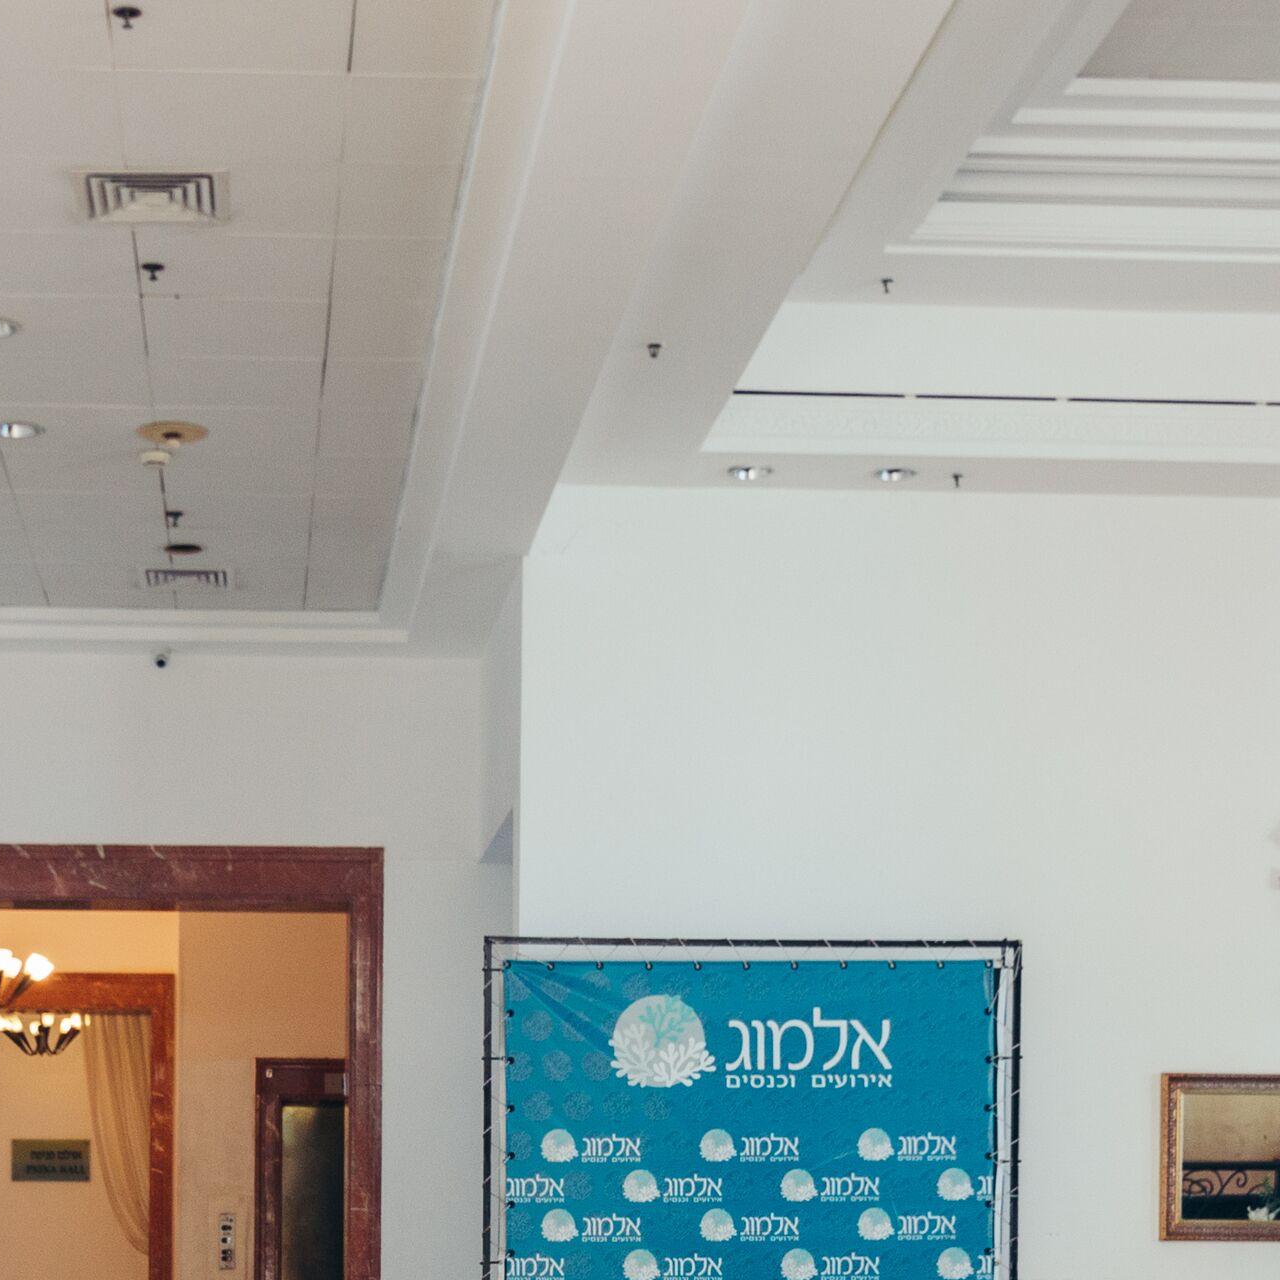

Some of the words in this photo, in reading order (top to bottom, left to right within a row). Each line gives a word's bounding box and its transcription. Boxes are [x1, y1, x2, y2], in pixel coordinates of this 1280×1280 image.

[726, 1007, 893, 1071] אלמוג
[725, 1073, 797, 1089] וכנסים
[811, 1073, 893, 1089] אירועים
[582, 1134, 641, 1156] אלמוג
[740, 1134, 799, 1156] אלמוג
[897, 1132, 956, 1154] אלמוג
[506, 1174, 565, 1196] אלמוג
[663, 1174, 722, 1196] אלמוג
[821, 1173, 880, 1195] אלמוג
[582, 1213, 641, 1235] אלמוג
[740, 1212, 799, 1234] אלמוג
[897, 1211, 956, 1233] אלמוג
[506, 1254, 565, 1276] אלמוג
[663, 1254, 722, 1276] אלמוג
[821, 1253, 880, 1275] אלמוג
